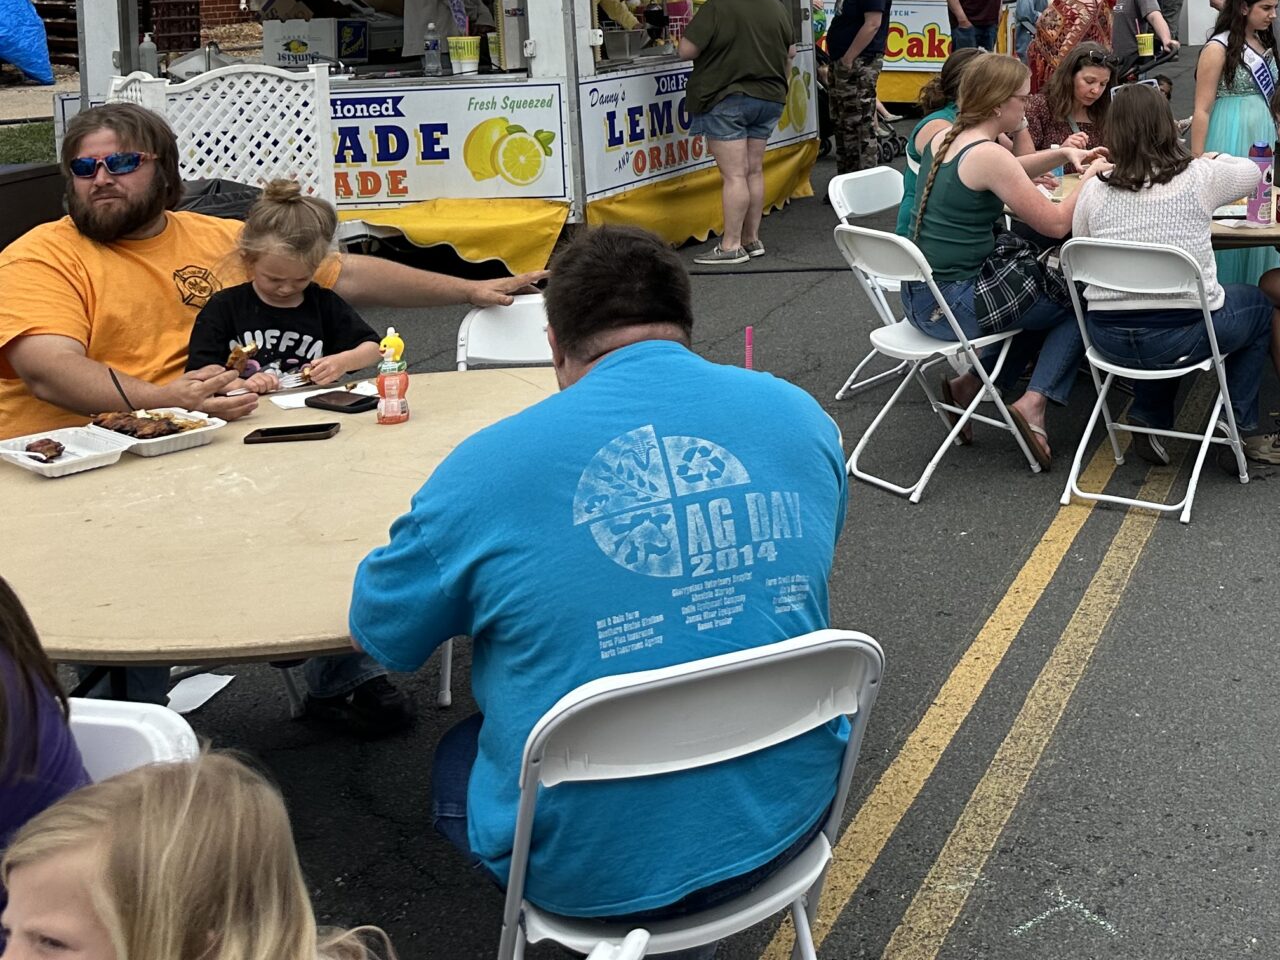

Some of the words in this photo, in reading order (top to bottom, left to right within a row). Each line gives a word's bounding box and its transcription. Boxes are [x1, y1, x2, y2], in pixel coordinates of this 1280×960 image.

[884, 26, 951, 57] Cak
[659, 77, 677, 93] Old
[678, 75, 688, 89] Fa
[1254, 62, 1271, 92] TEEN
[468, 97, 497, 112] Fresh
[501, 94, 553, 113] Squeezed
[589, 83, 626, 107] Danny's
[604, 96, 693, 151] LEMO
[686, 497, 737, 555] AG
[745, 491, 803, 542] DAY
[690, 541, 778, 578] 2014
